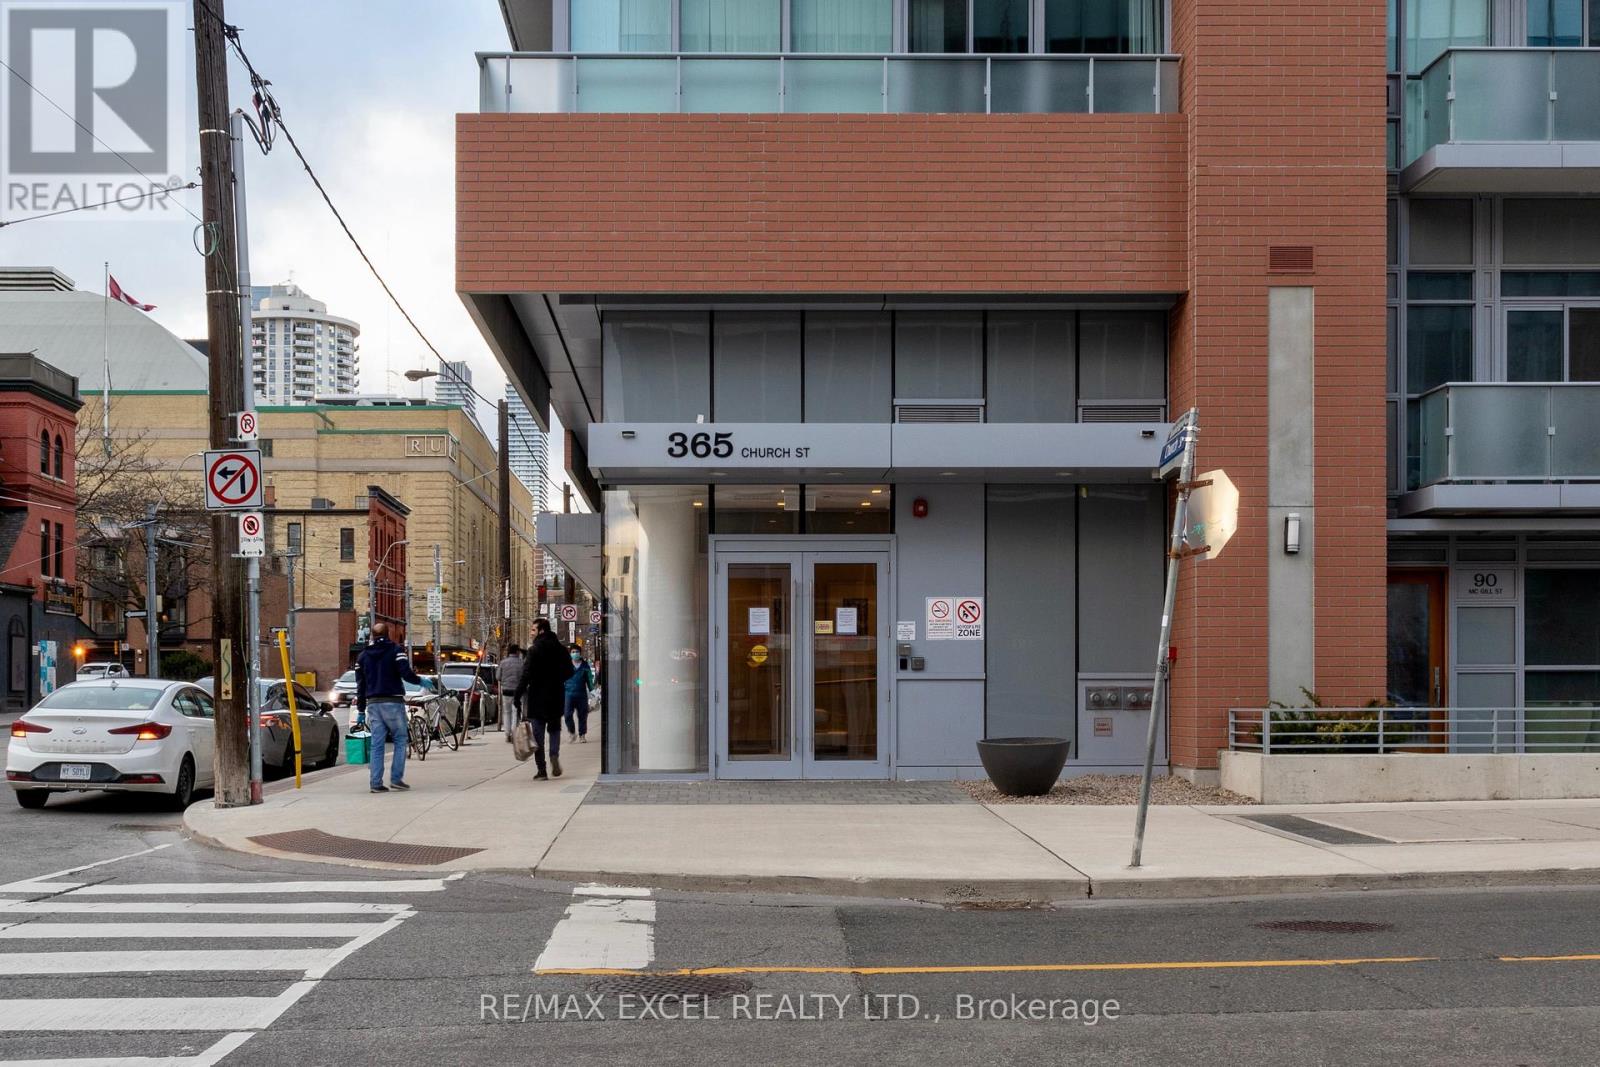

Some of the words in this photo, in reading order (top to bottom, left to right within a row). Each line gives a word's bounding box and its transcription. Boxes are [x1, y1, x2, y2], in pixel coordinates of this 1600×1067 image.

[667, 432, 734, 459] 365
[741, 447, 791, 459] CHURCH
[795, 447, 810, 459] ST
[1474, 573, 1497, 587] 90
[957, 629, 981, 637] ZONE
